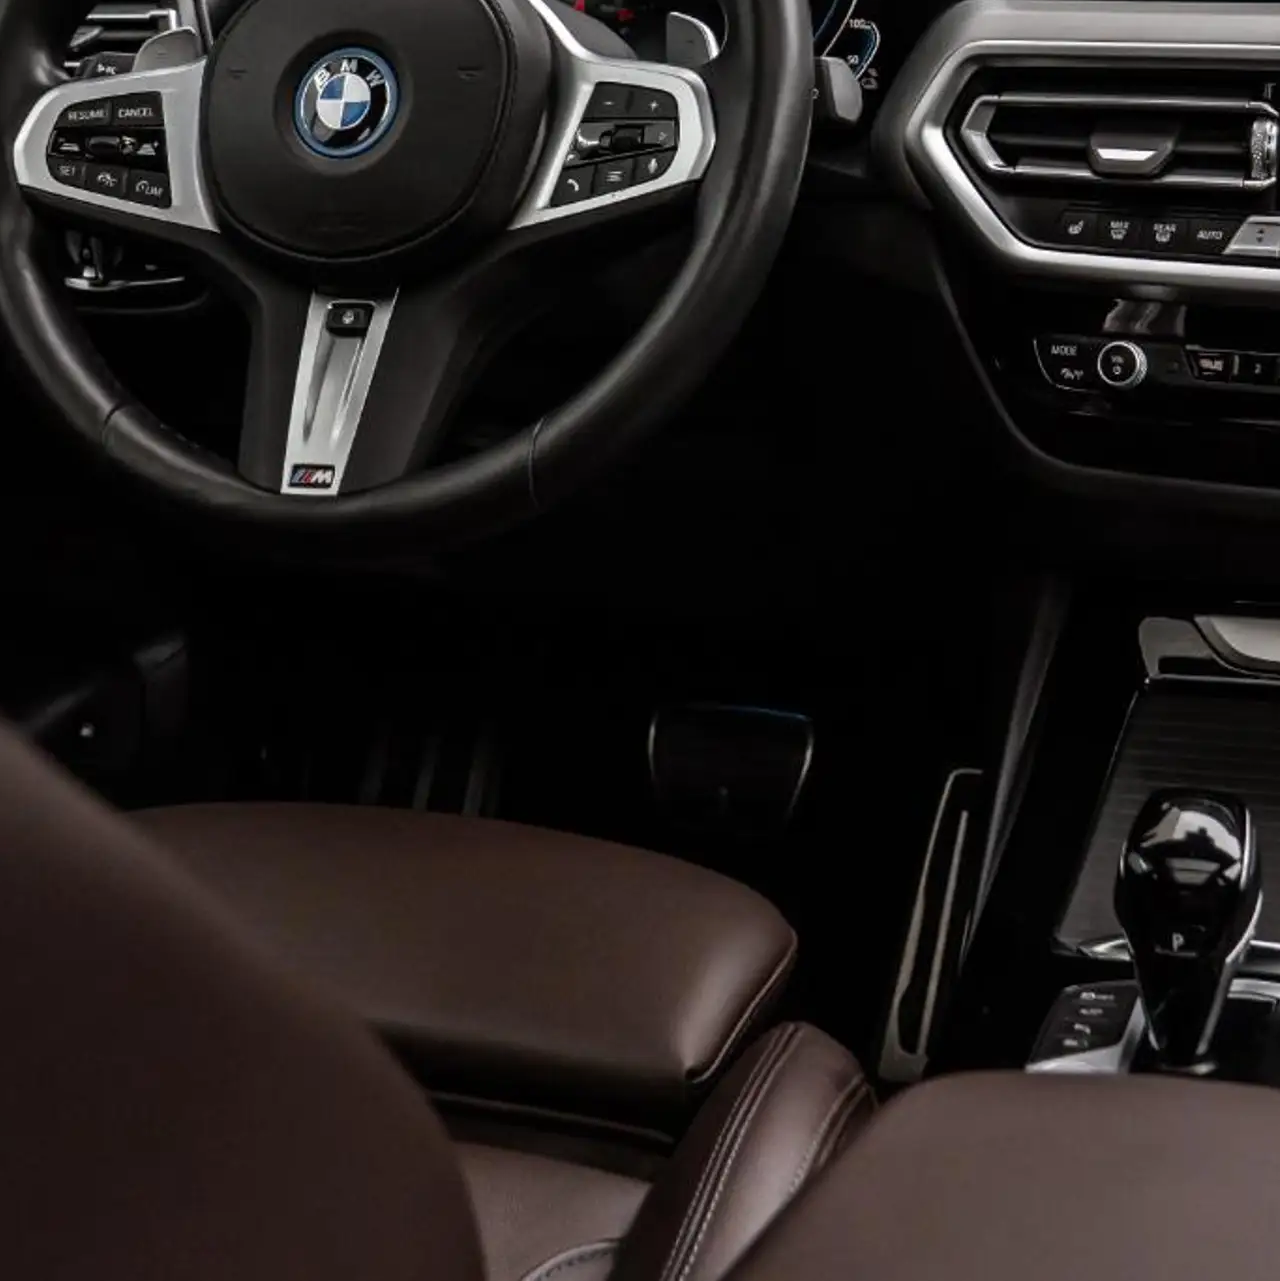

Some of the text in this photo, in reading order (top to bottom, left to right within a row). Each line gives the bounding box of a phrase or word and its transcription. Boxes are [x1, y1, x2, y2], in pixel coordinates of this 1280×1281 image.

[314, 58, 385, 94] BMW
[67, 108, 106, 121] RESUME
[117, 106, 154, 119] CANCEL
[58, 165, 76, 177] SET
[1196, 230, 1223, 240] AUTO
[1051, 344, 1077, 356] MODE
[1172, 933, 1184, 952] P
